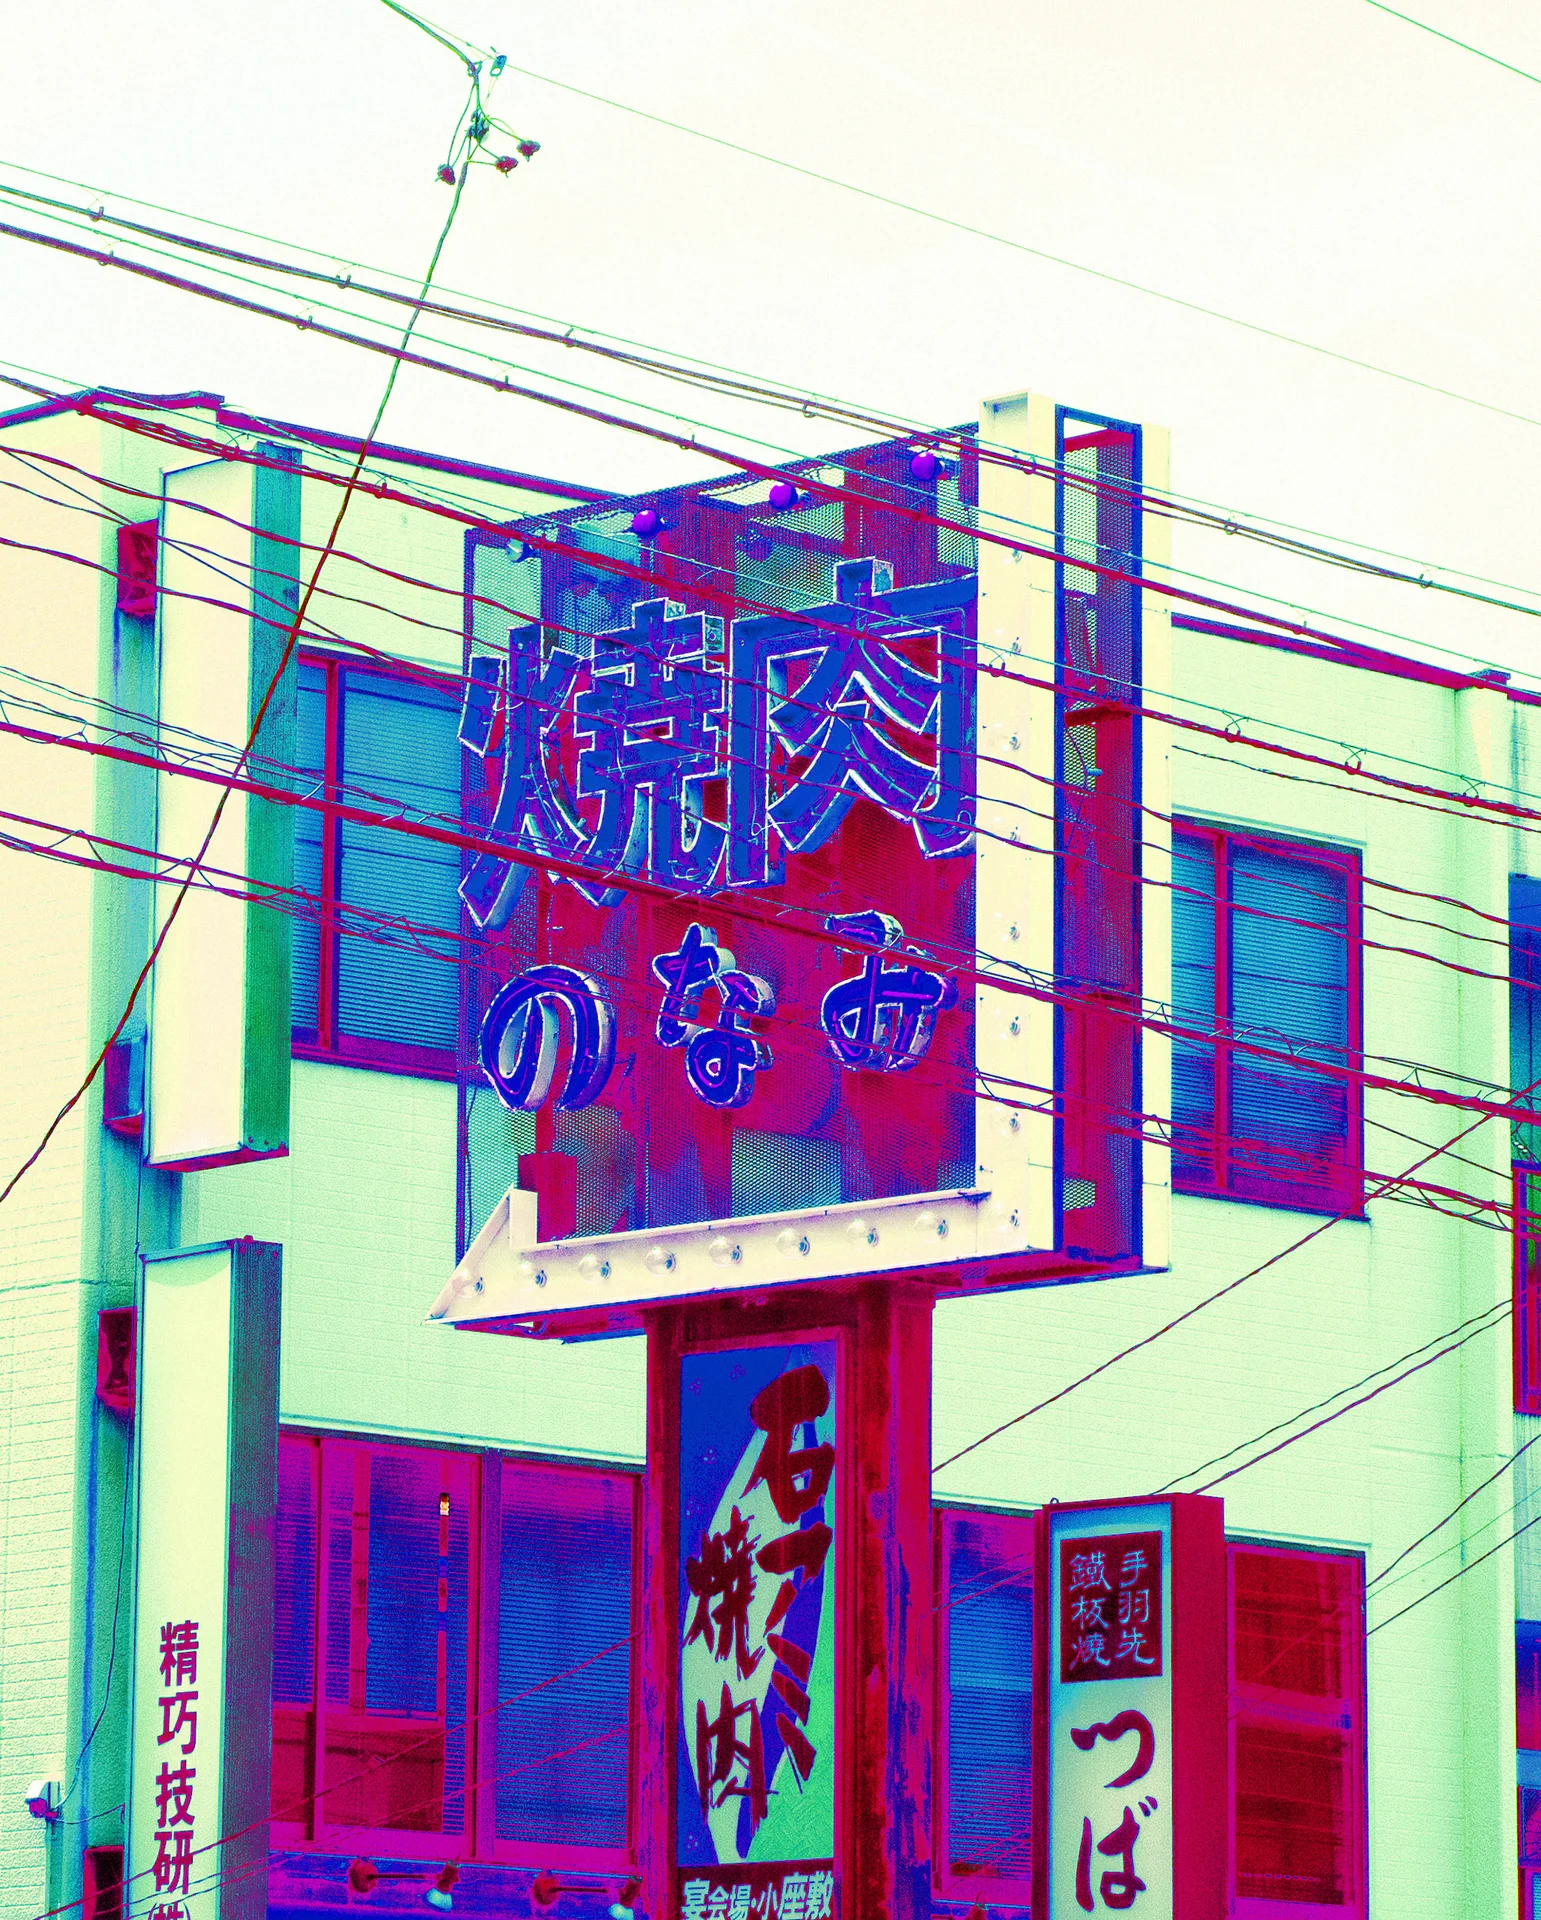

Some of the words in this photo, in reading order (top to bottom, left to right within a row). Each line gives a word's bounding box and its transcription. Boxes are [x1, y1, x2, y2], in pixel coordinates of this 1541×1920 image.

[683, 1506, 779, 1837] 焼肉
[1115, 1549, 1155, 1666] 手羽先
[1070, 1709, 1159, 1912] つば
